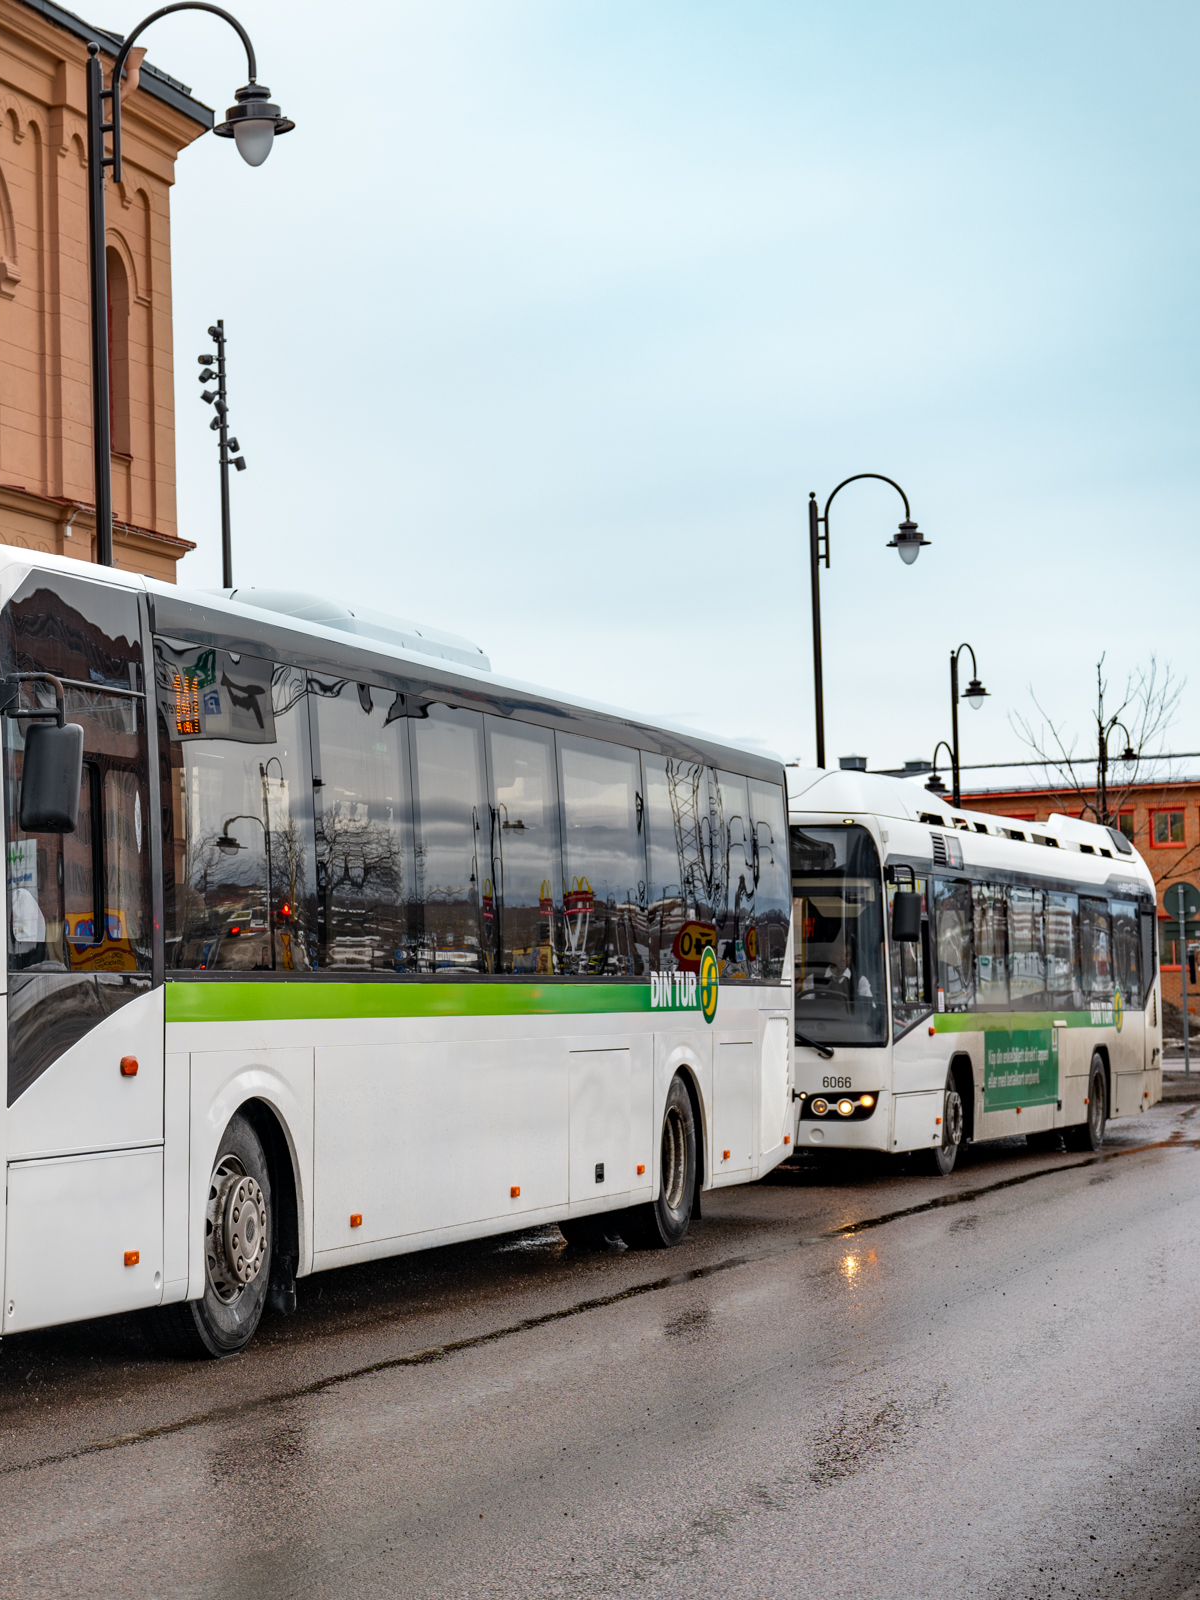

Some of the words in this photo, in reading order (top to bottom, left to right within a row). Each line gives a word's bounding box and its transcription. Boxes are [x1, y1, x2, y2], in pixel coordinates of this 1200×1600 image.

[650, 970, 672, 1008] DIN
[674, 970, 697, 1007] TUR
[822, 1076, 852, 1088] 6066
